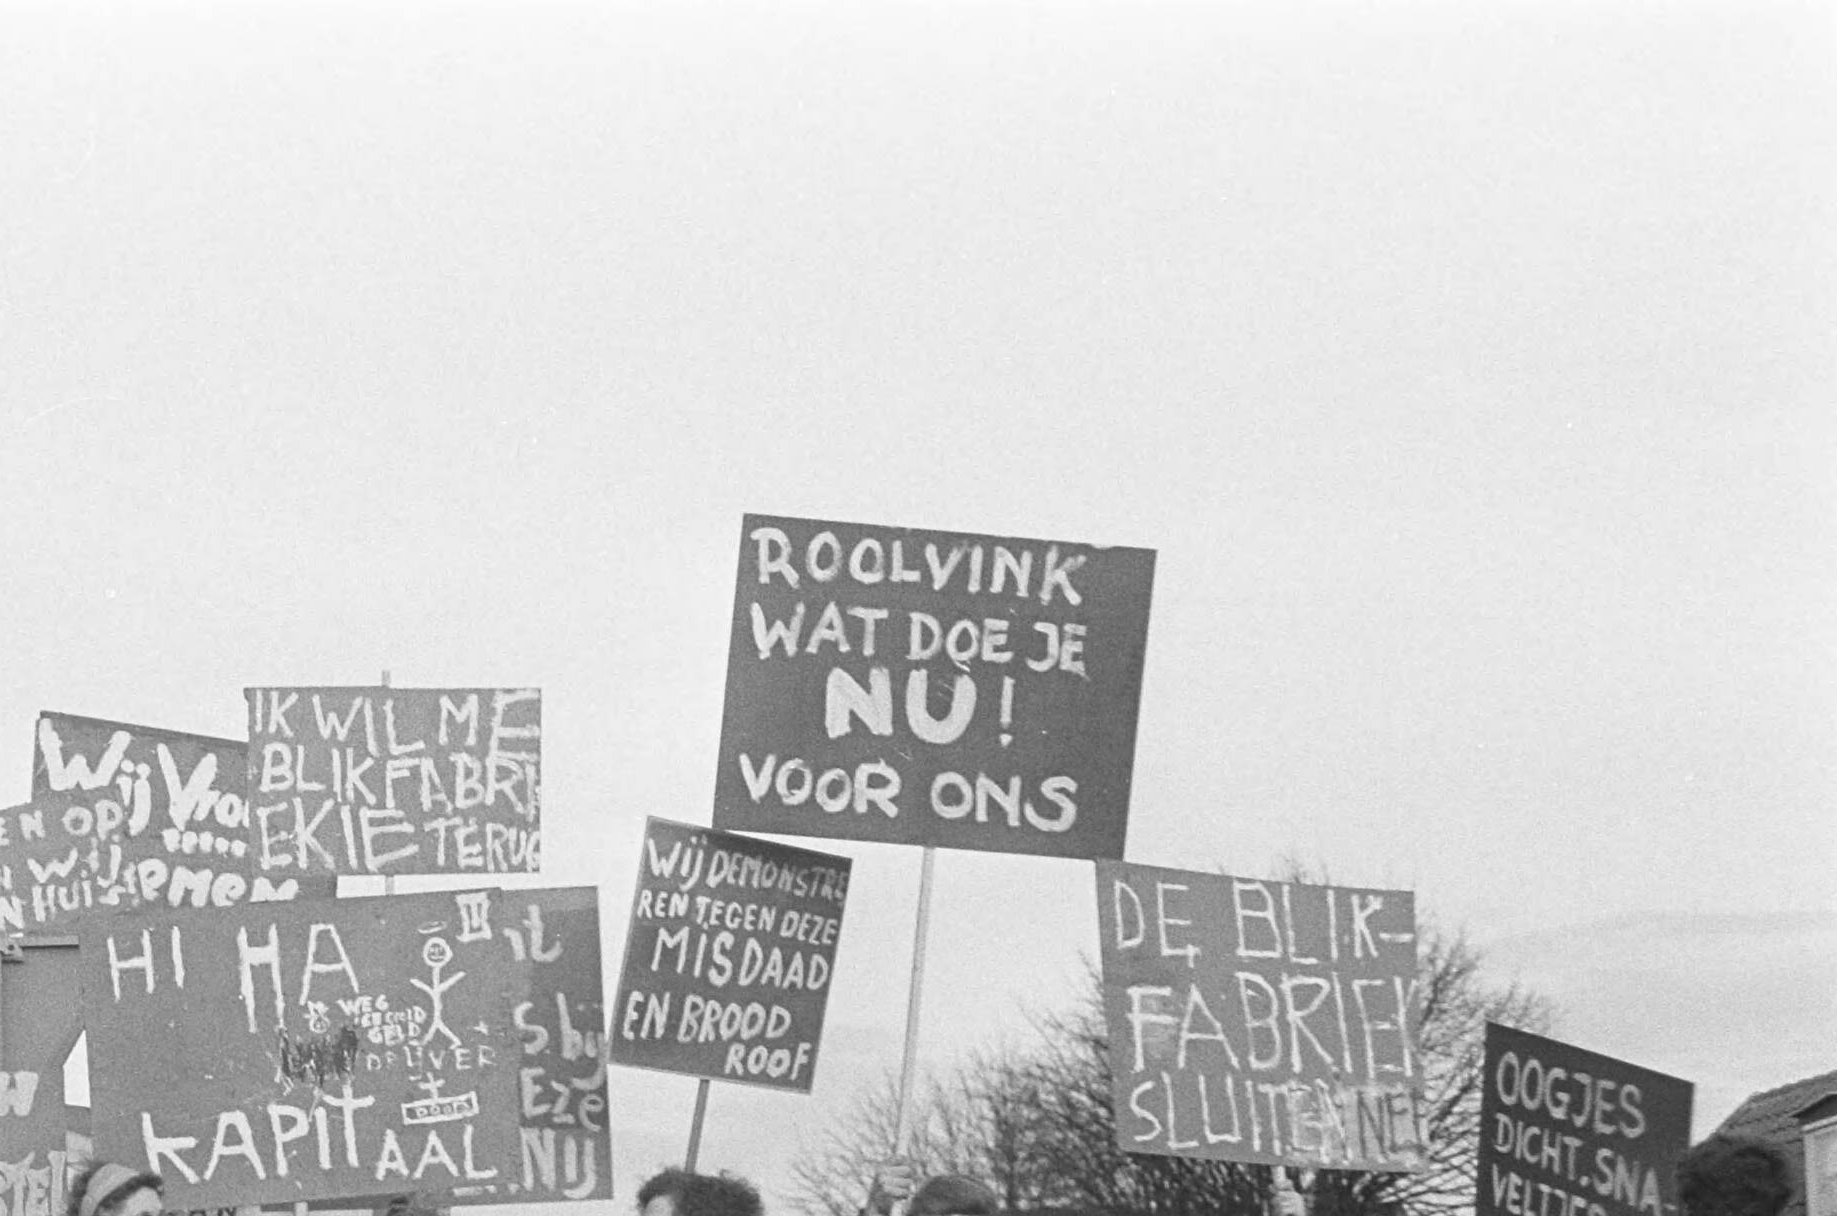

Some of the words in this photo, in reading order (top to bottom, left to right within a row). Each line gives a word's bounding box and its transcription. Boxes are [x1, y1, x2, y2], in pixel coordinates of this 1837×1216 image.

[751, 527, 1087, 606] ROOLVINK
[751, 602, 889, 659] WAT
[907, 611, 1014, 670] DOE
[1026, 621, 1090, 678] JE
[255, 688, 299, 738] IK
[312, 693, 426, 759] WIL
[439, 688, 541, 761] ME
[37, 717, 153, 837] Wij
[156, 742, 250, 832] Vro
[738, 752, 901, 819] VOOR
[930, 770, 1078, 832] ONS
[62, 800, 123, 842] OP
[255, 796, 420, 874] EKIE
[637, 889, 690, 920] REN
[696, 894, 777, 933] TEGEN
[779, 909, 839, 946] DEZE
[1233, 877, 1415, 964] BLIK-
[106, 924, 185, 1002] HI
[236, 921, 361, 1034] HA
[621, 990, 671, 1041] EN
[677, 994, 792, 1043] BROOD
[723, 1041, 813, 1081] ROOF
[1496, 1051, 1646, 1138] OOGJES
[1493, 1112, 1590, 1188] DICHT.
